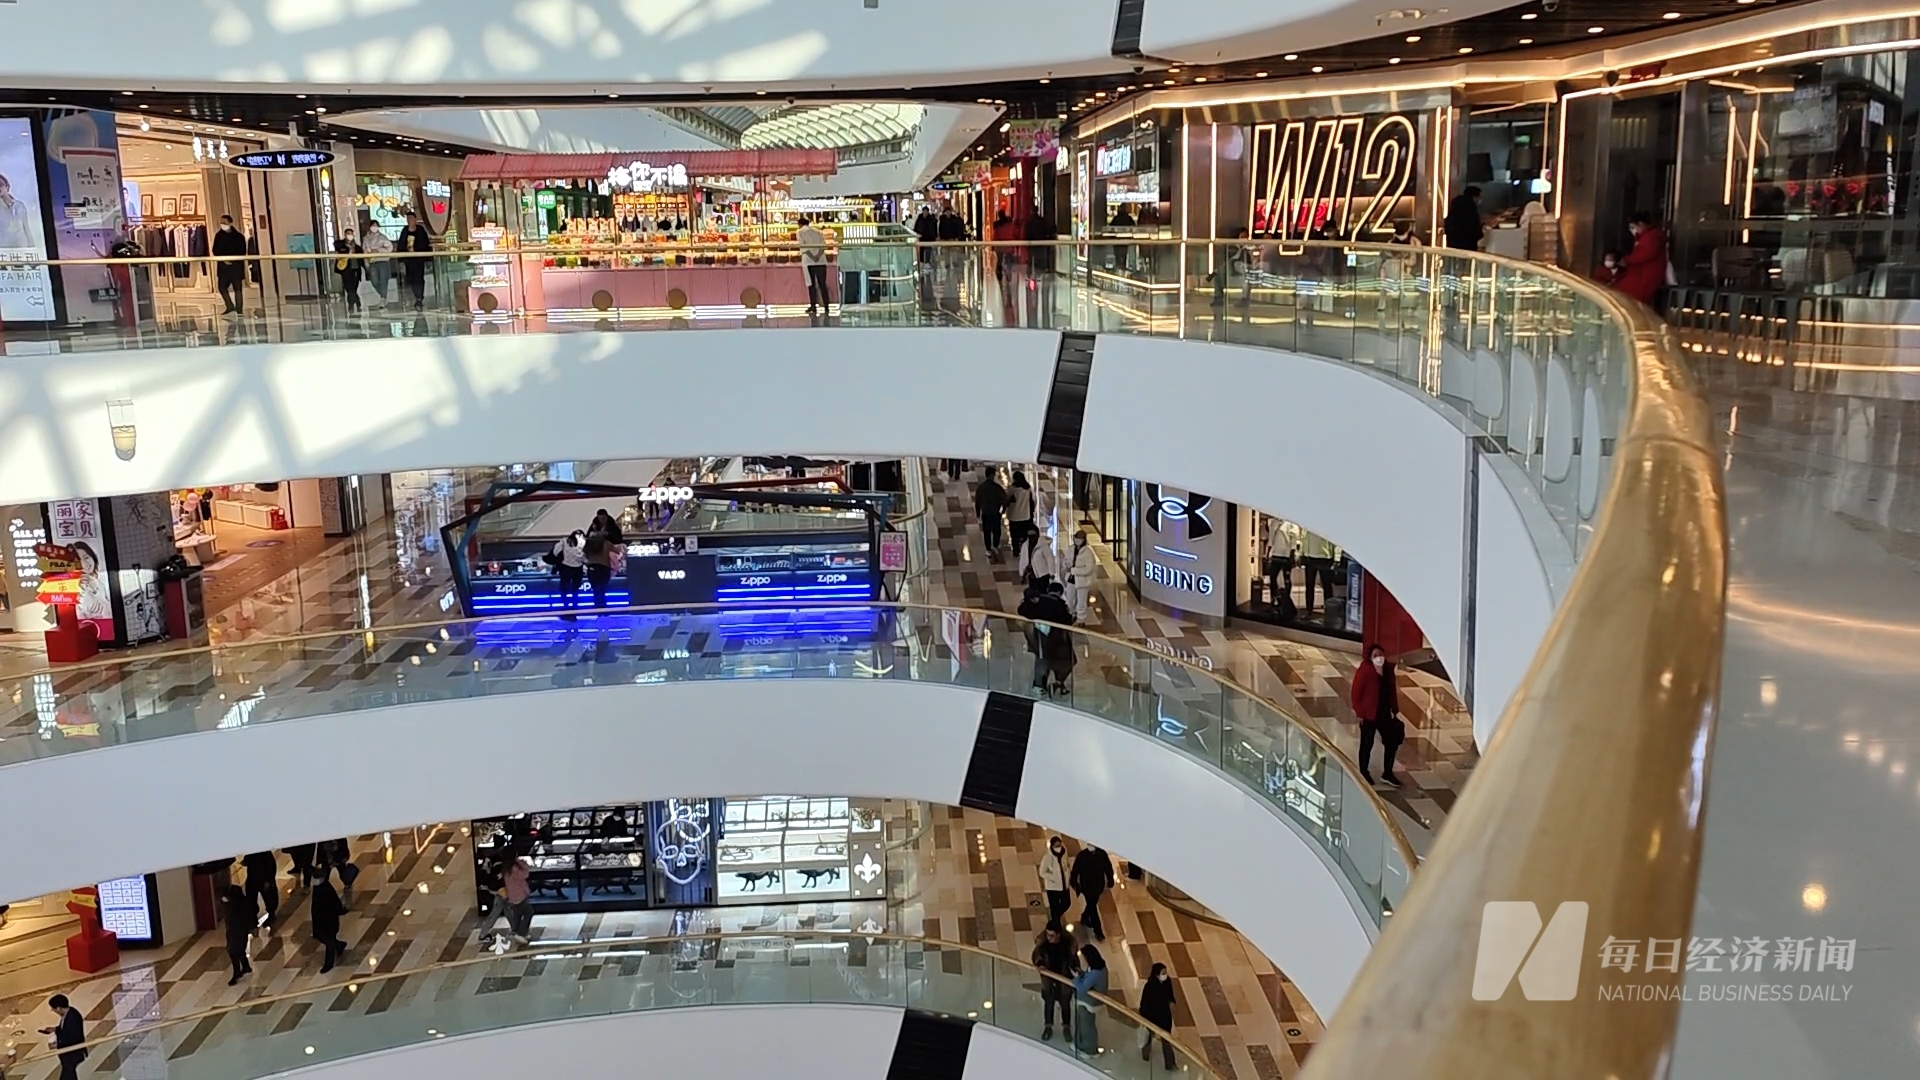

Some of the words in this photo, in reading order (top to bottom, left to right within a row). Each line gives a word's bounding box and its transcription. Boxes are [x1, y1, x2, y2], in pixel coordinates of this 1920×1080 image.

[1249, 115, 1415, 255] W12
[17, 272, 41, 280] HAIR
[638, 485, 694, 504] zippo
[57, 501, 93, 519] 丽家
[59, 520, 94, 537] 宝贝
[740, 577, 771, 587] zippo
[817, 574, 848, 585] zippo
[1144, 560, 1213, 595] BEIJING
[495, 584, 527, 594] zippo
